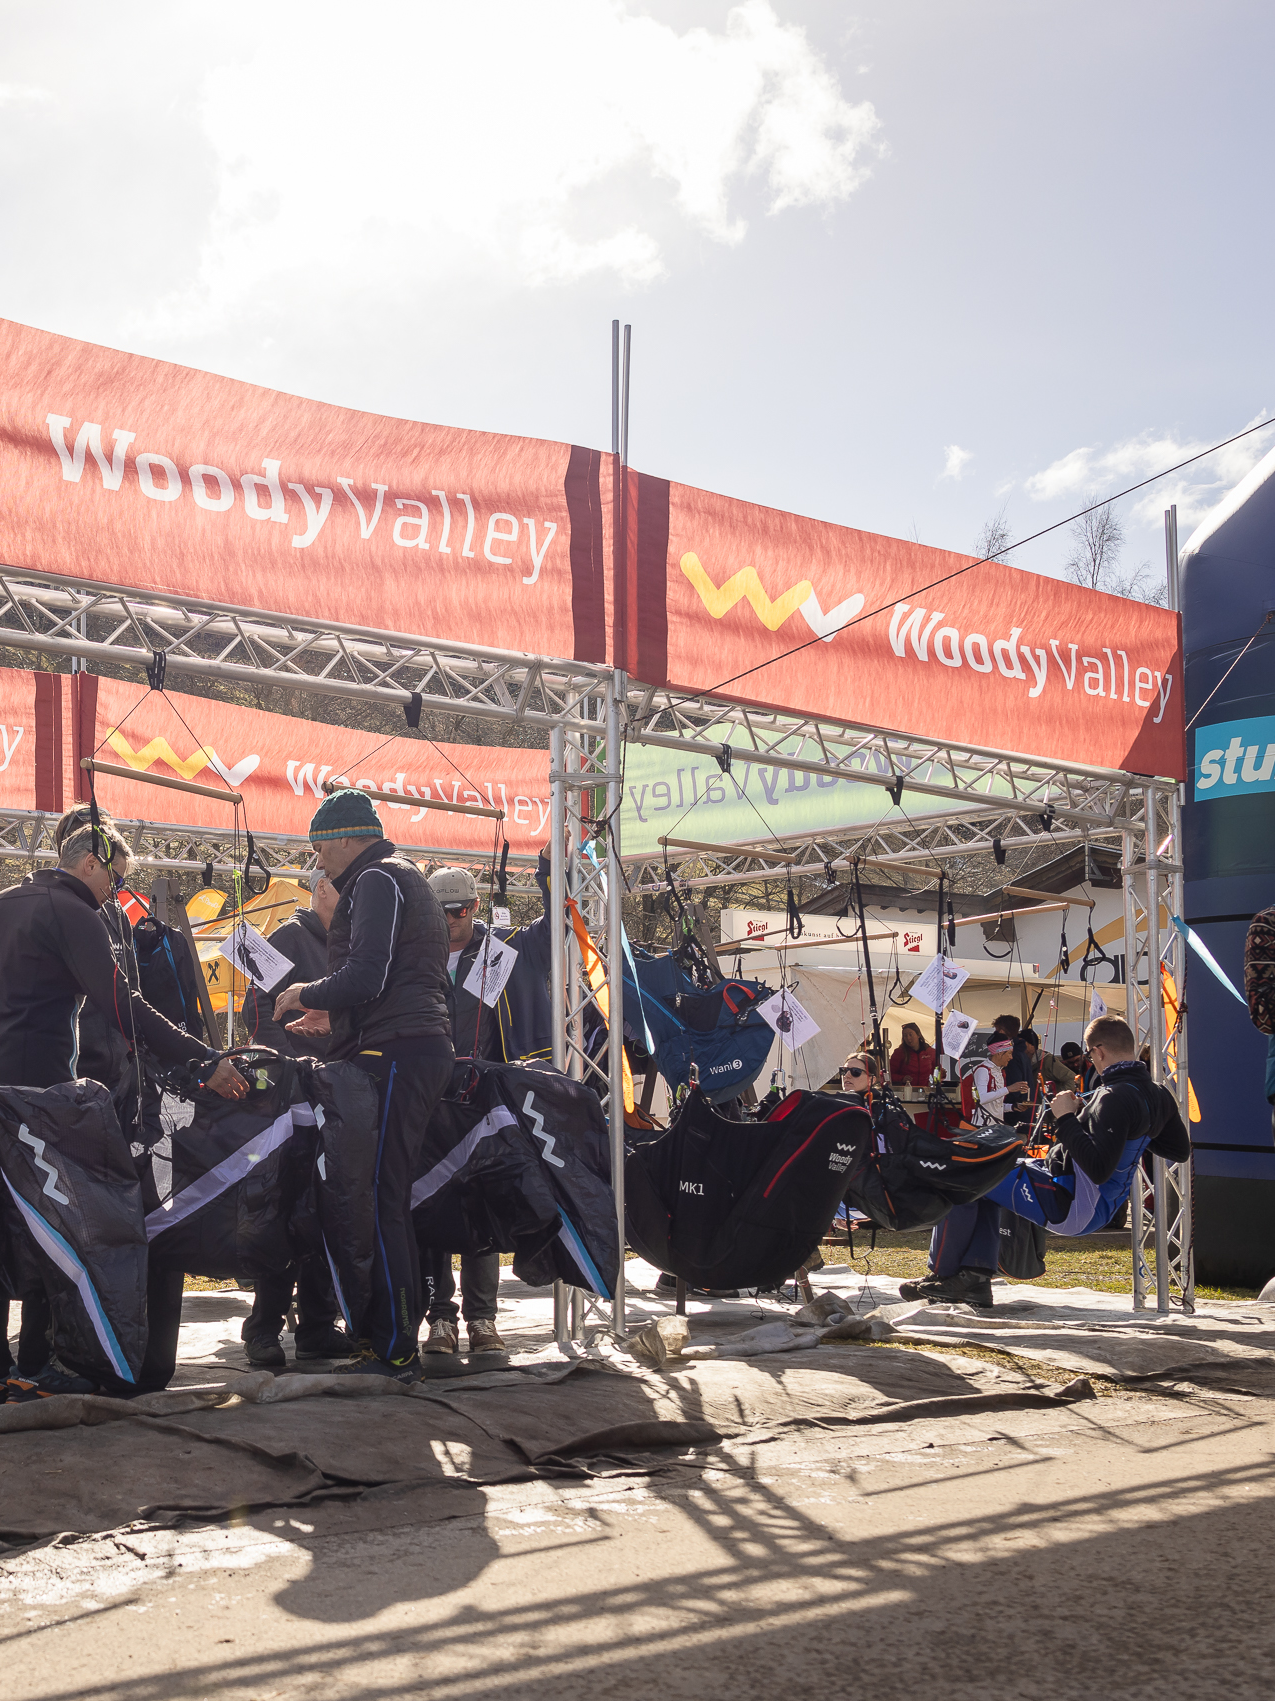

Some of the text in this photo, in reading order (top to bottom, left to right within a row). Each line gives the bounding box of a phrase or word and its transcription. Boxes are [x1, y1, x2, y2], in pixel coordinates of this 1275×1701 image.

[45, 412, 558, 585] WoodyValley
[888, 602, 1173, 724] WoodyValley
[1196, 736, 1275, 790] stu
[747, 920, 769, 937] Stiegl
[903, 932, 923, 948] Stiegl
[829, 1152, 853, 1166] Woody
[679, 1180, 705, 1196] MK1
[425, 1276, 436, 1309] RAC
